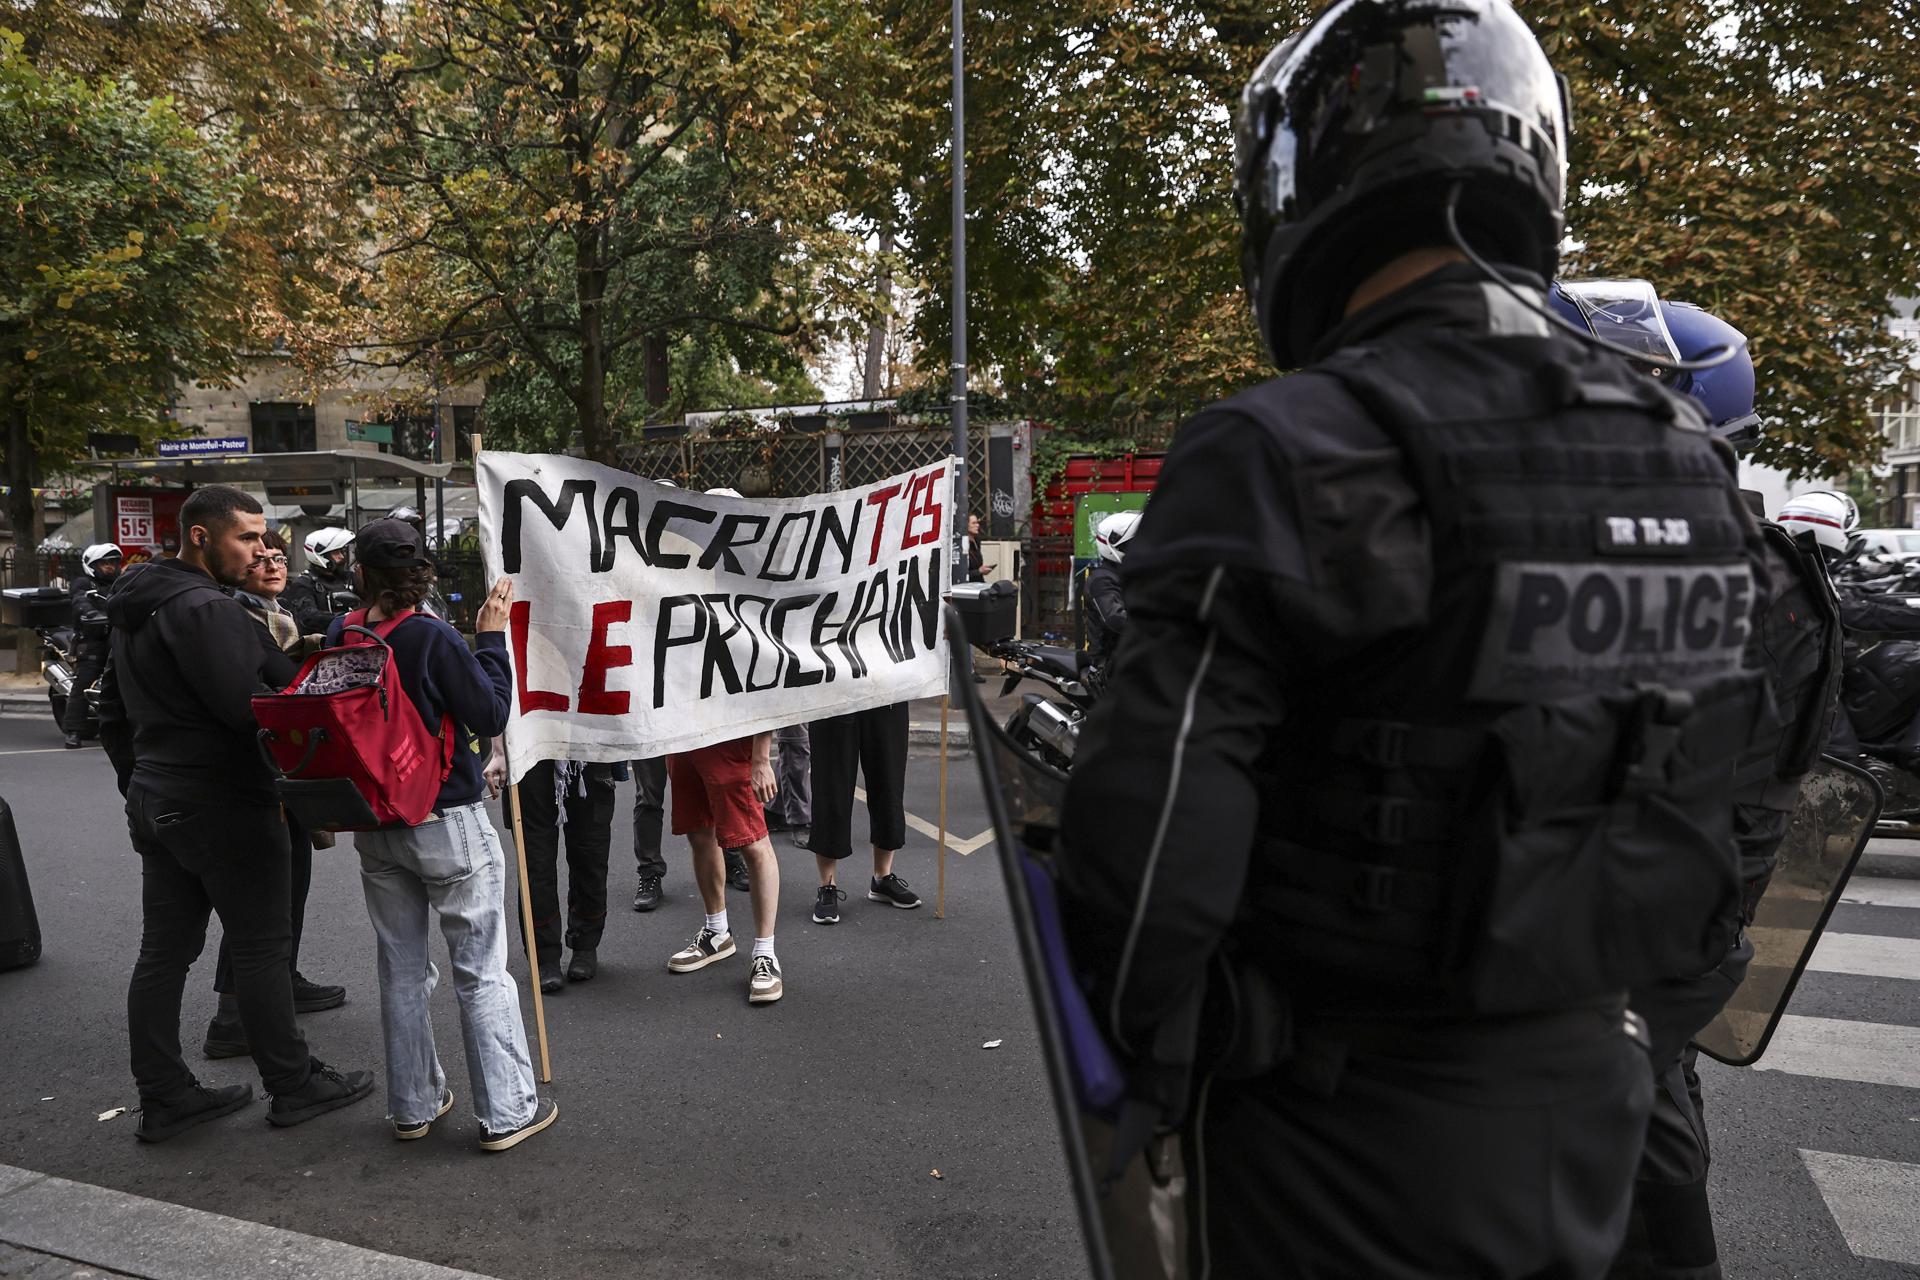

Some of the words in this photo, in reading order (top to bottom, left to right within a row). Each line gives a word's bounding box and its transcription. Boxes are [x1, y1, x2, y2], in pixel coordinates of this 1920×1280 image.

[160, 443, 180, 451] Mairie
[180, 442, 188, 450] de
[501, 479, 862, 581] MACRON
[867, 467, 945, 565] T'ES
[509, 600, 633, 717] LE
[1506, 572, 1749, 655] POLICE
